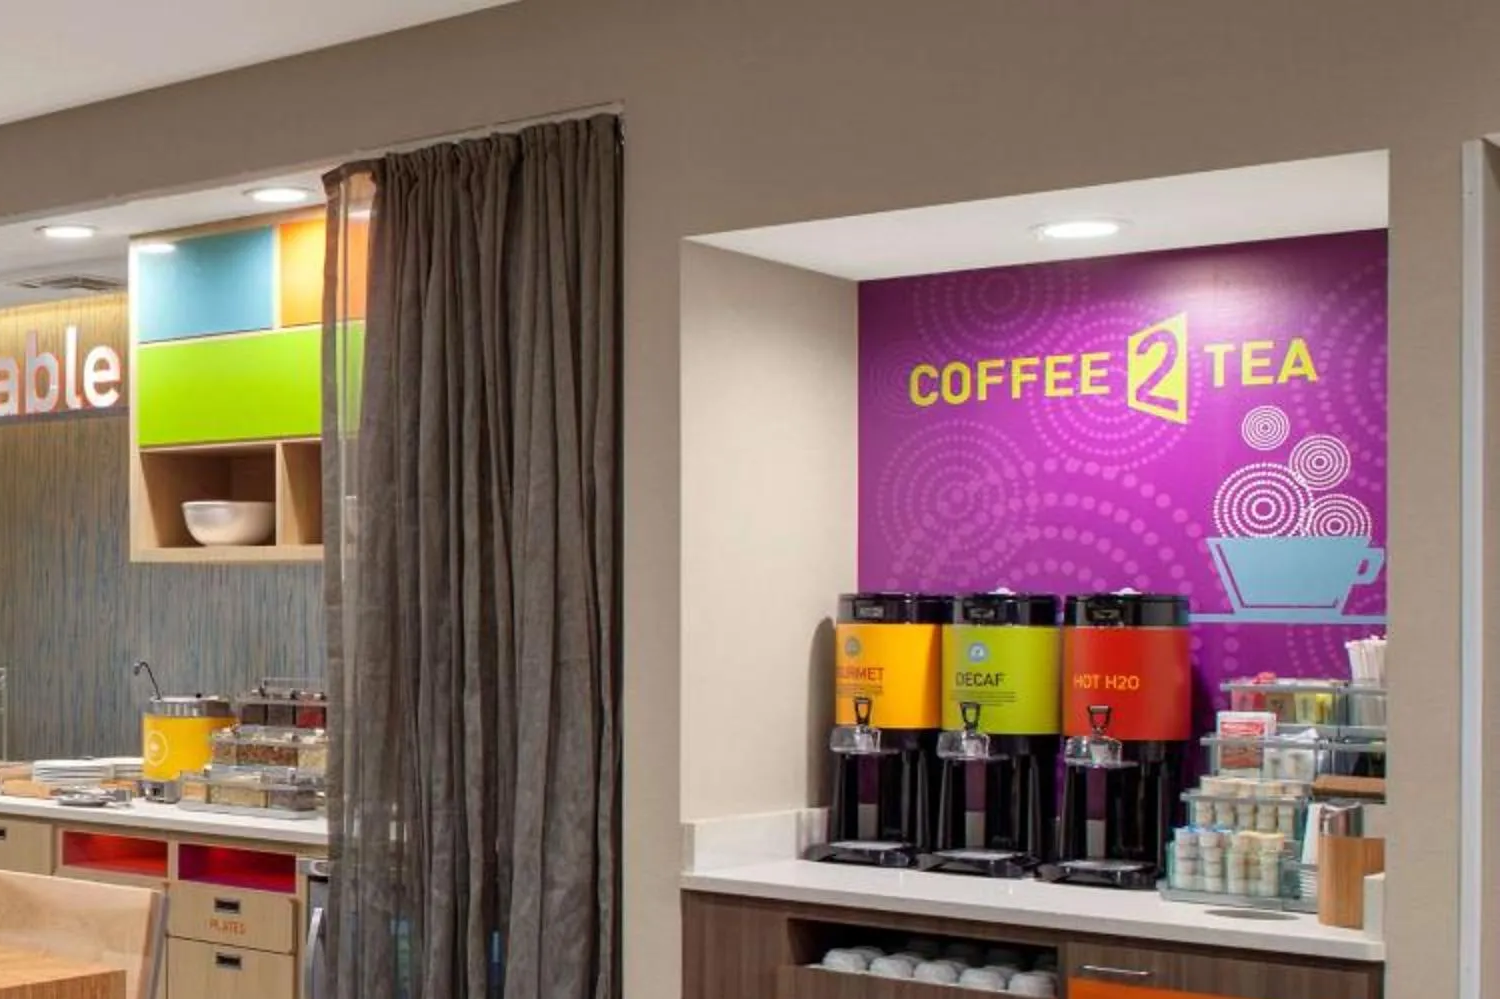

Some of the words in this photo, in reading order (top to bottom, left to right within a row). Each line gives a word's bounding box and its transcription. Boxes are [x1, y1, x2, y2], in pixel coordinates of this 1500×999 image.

[908, 351, 1112, 408] COFFEE
[1133, 328, 1180, 412] 2
[1203, 336, 1321, 388] TEA
[955, 671, 1006, 688] DECAF
[1073, 673, 1100, 690] HOT
[1104, 673, 1140, 691] H2O
